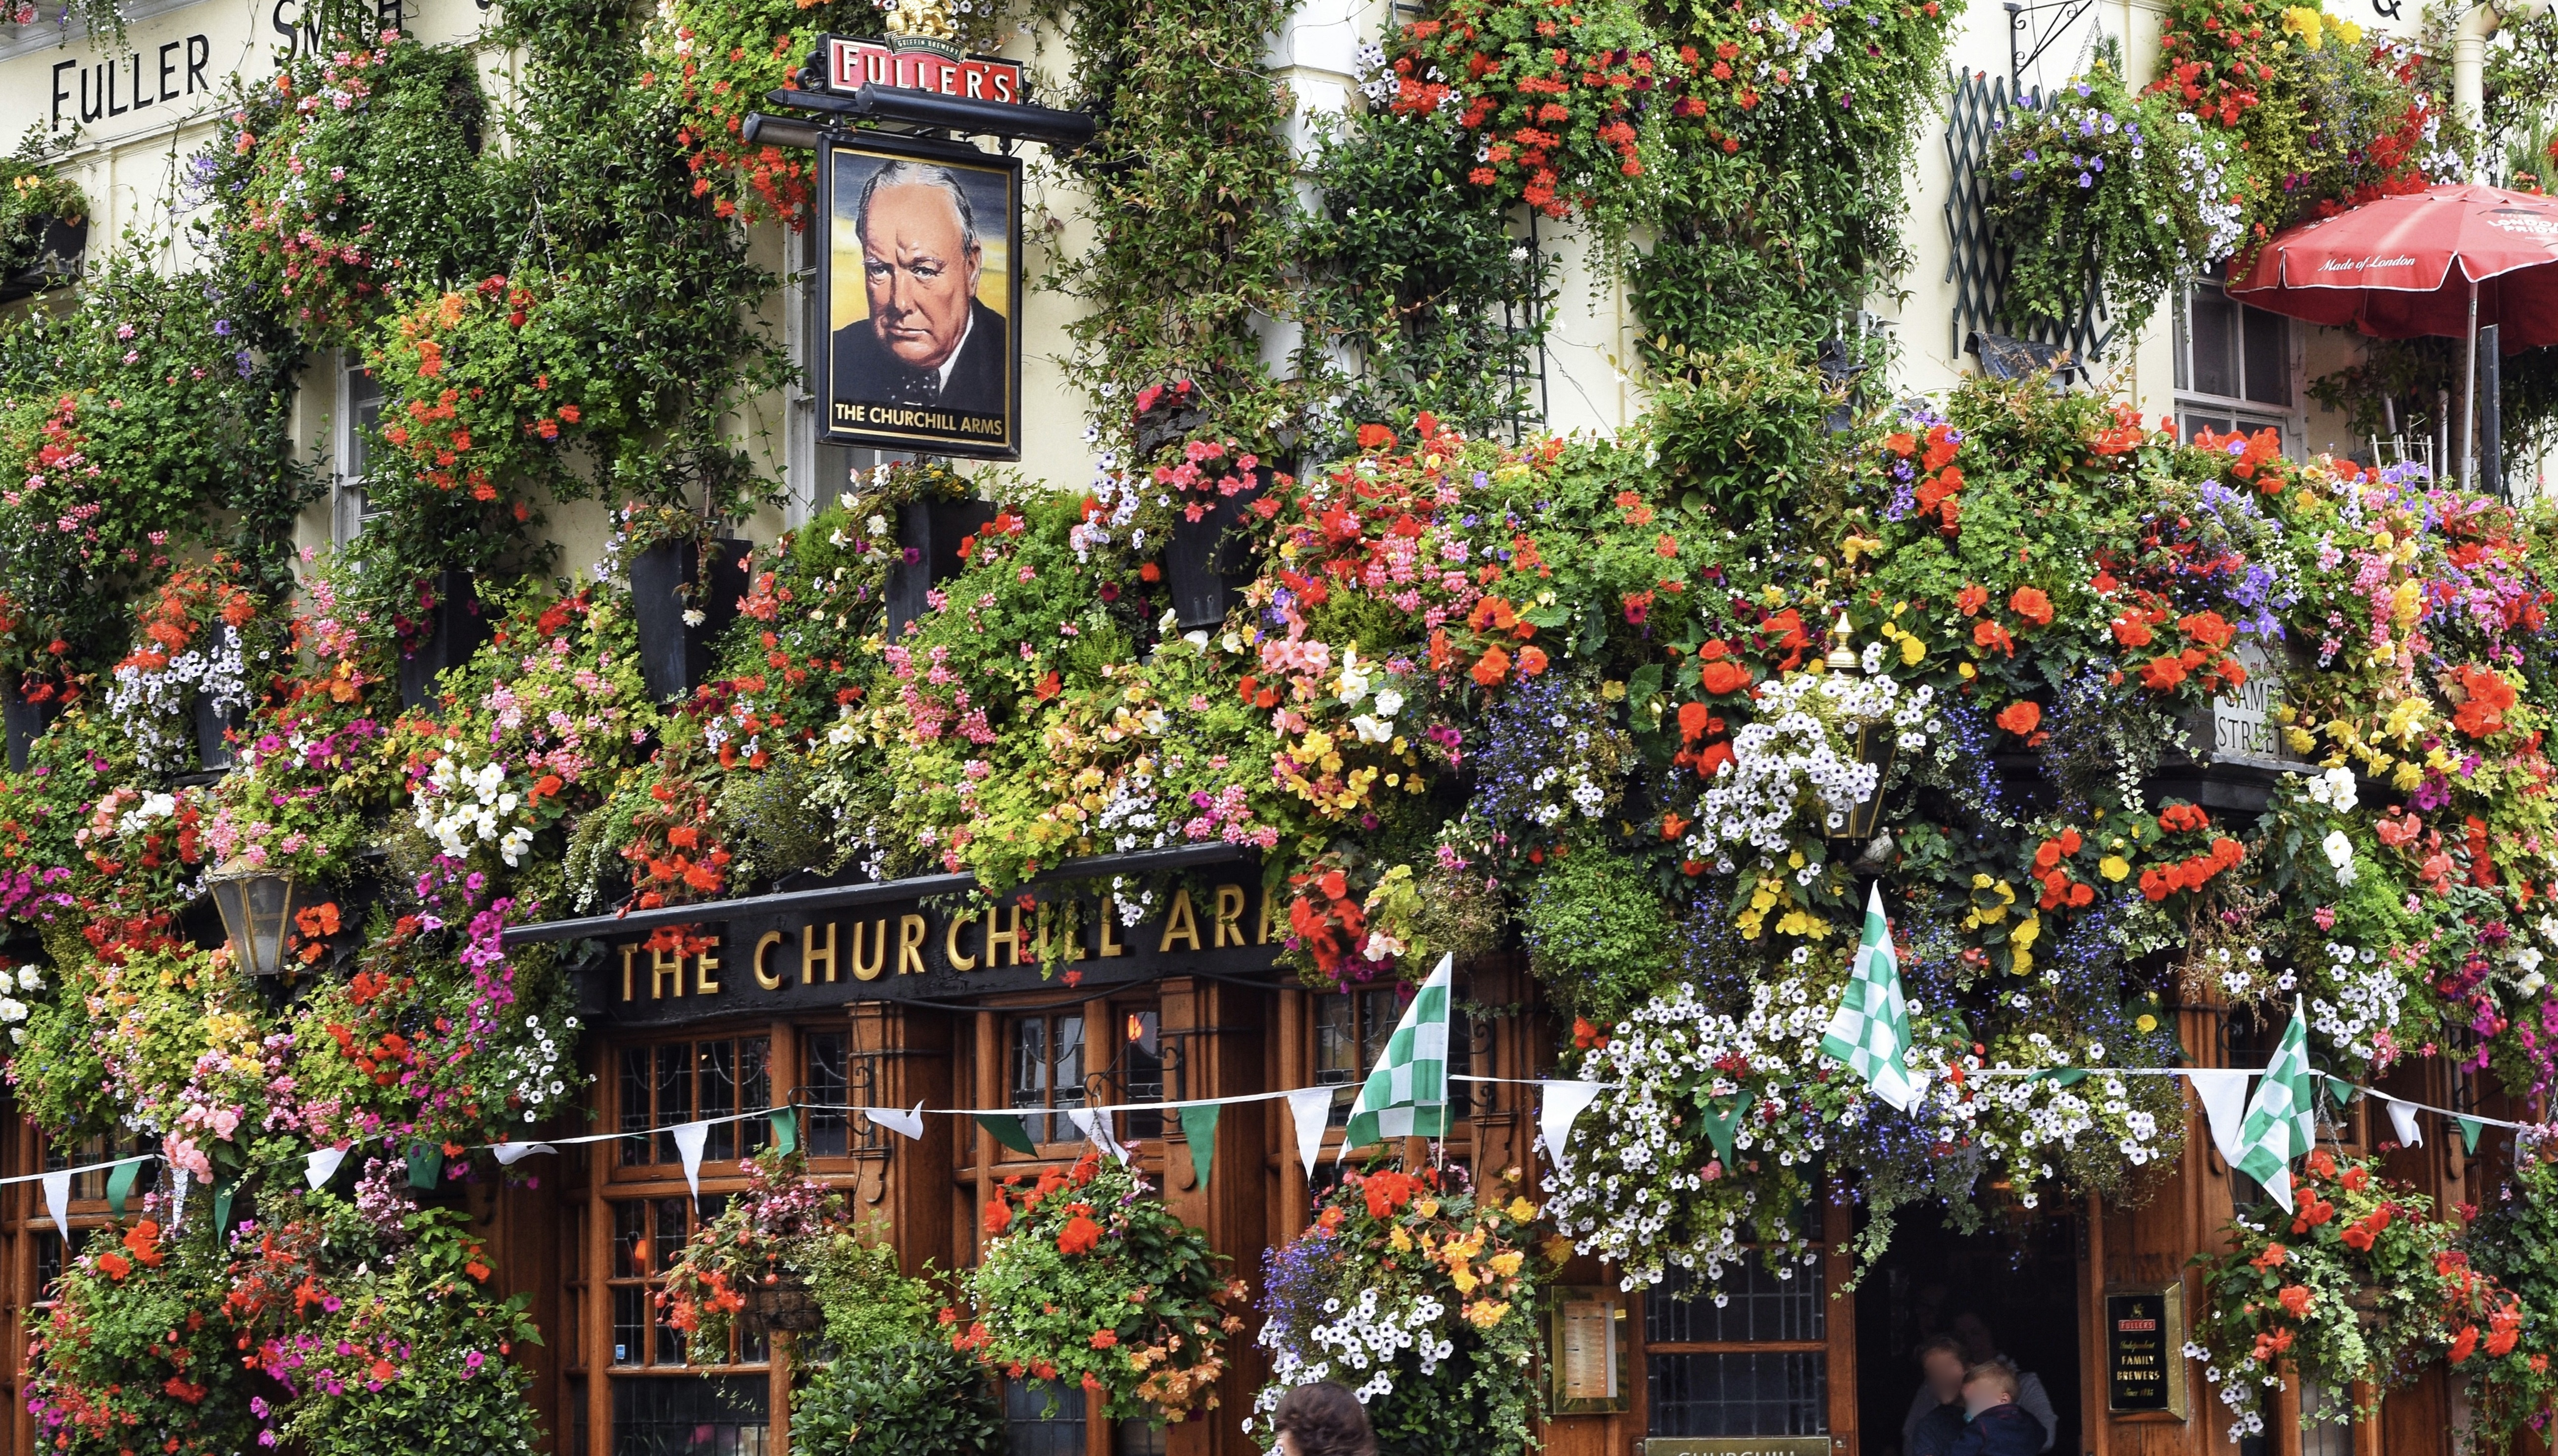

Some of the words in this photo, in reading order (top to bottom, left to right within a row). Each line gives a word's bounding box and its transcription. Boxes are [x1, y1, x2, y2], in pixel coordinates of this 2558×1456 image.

[928, 40, 959, 55] BREWERY
[52, 34, 209, 132] FULLER
[842, 45, 1010, 103] FULLER'S
[2317, 257, 2355, 272] Made
[2355, 255, 2371, 272] of
[2366, 253, 2416, 268] London
[835, 403, 865, 422] THE
[869, 406, 956, 431] CHURCHILL
[960, 416, 1003, 436] ARMS
[617, 934, 721, 1002] THE
[752, 896, 1123, 991] CHURCHILL
[2121, 1356, 2155, 1365] FAMILY
[2116, 1370, 2160, 1380] BREWERS
